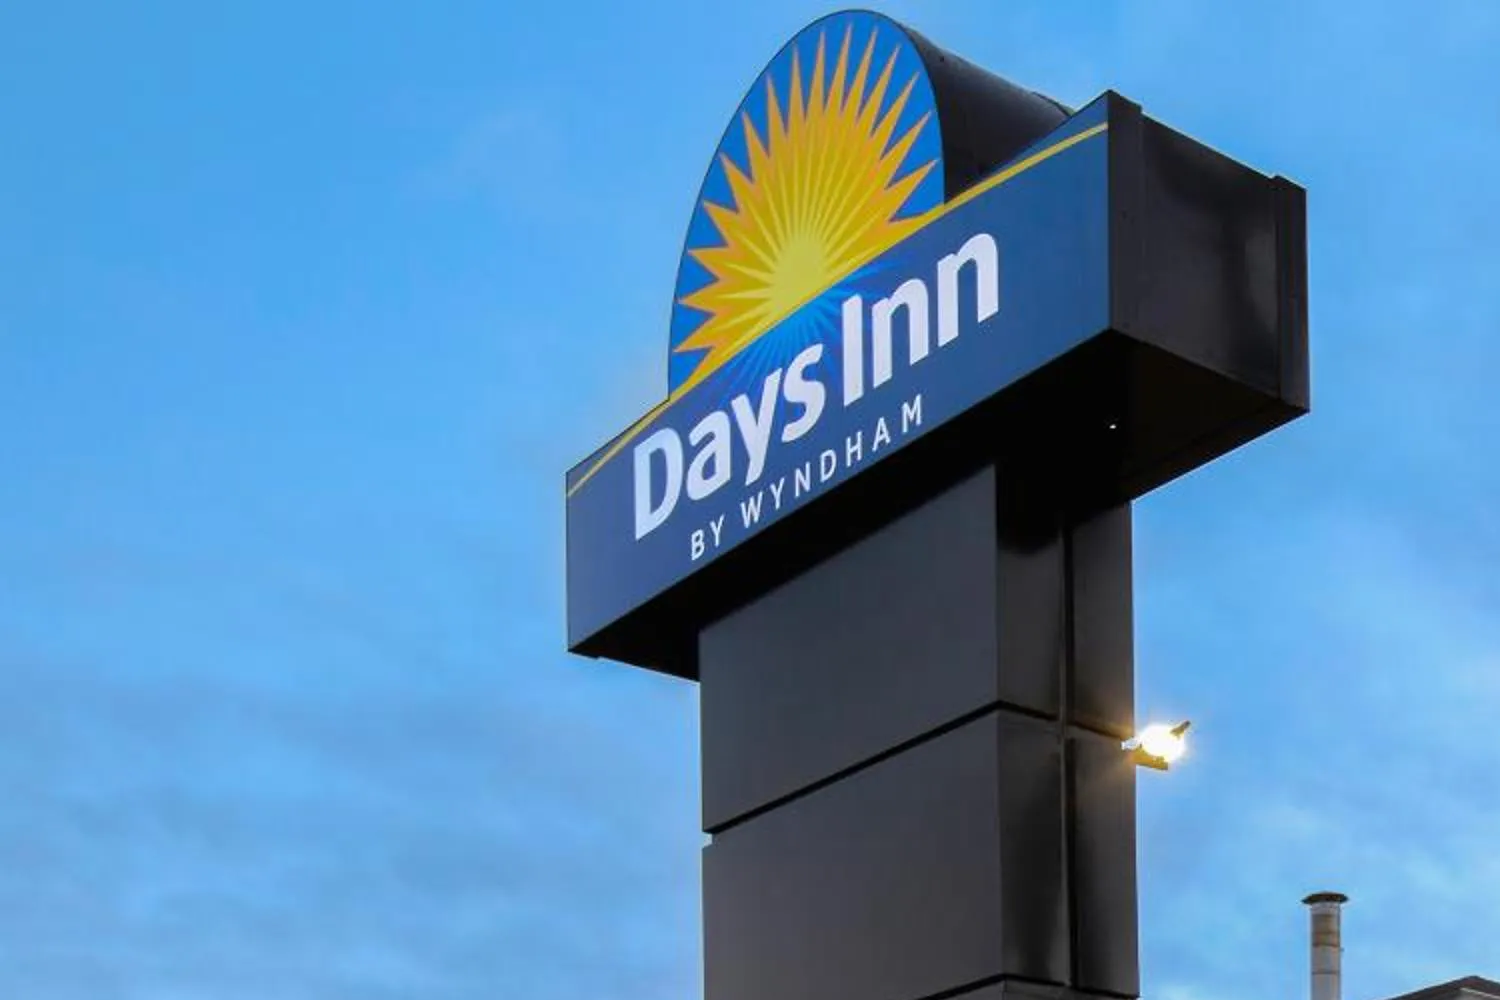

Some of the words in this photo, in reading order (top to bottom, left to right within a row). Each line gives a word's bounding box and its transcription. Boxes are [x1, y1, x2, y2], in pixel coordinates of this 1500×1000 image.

[633, 342, 827, 541] Days
[842, 232, 1000, 408] Inn
[690, 515, 725, 562] BY
[740, 394, 923, 529] WYNDHAM
